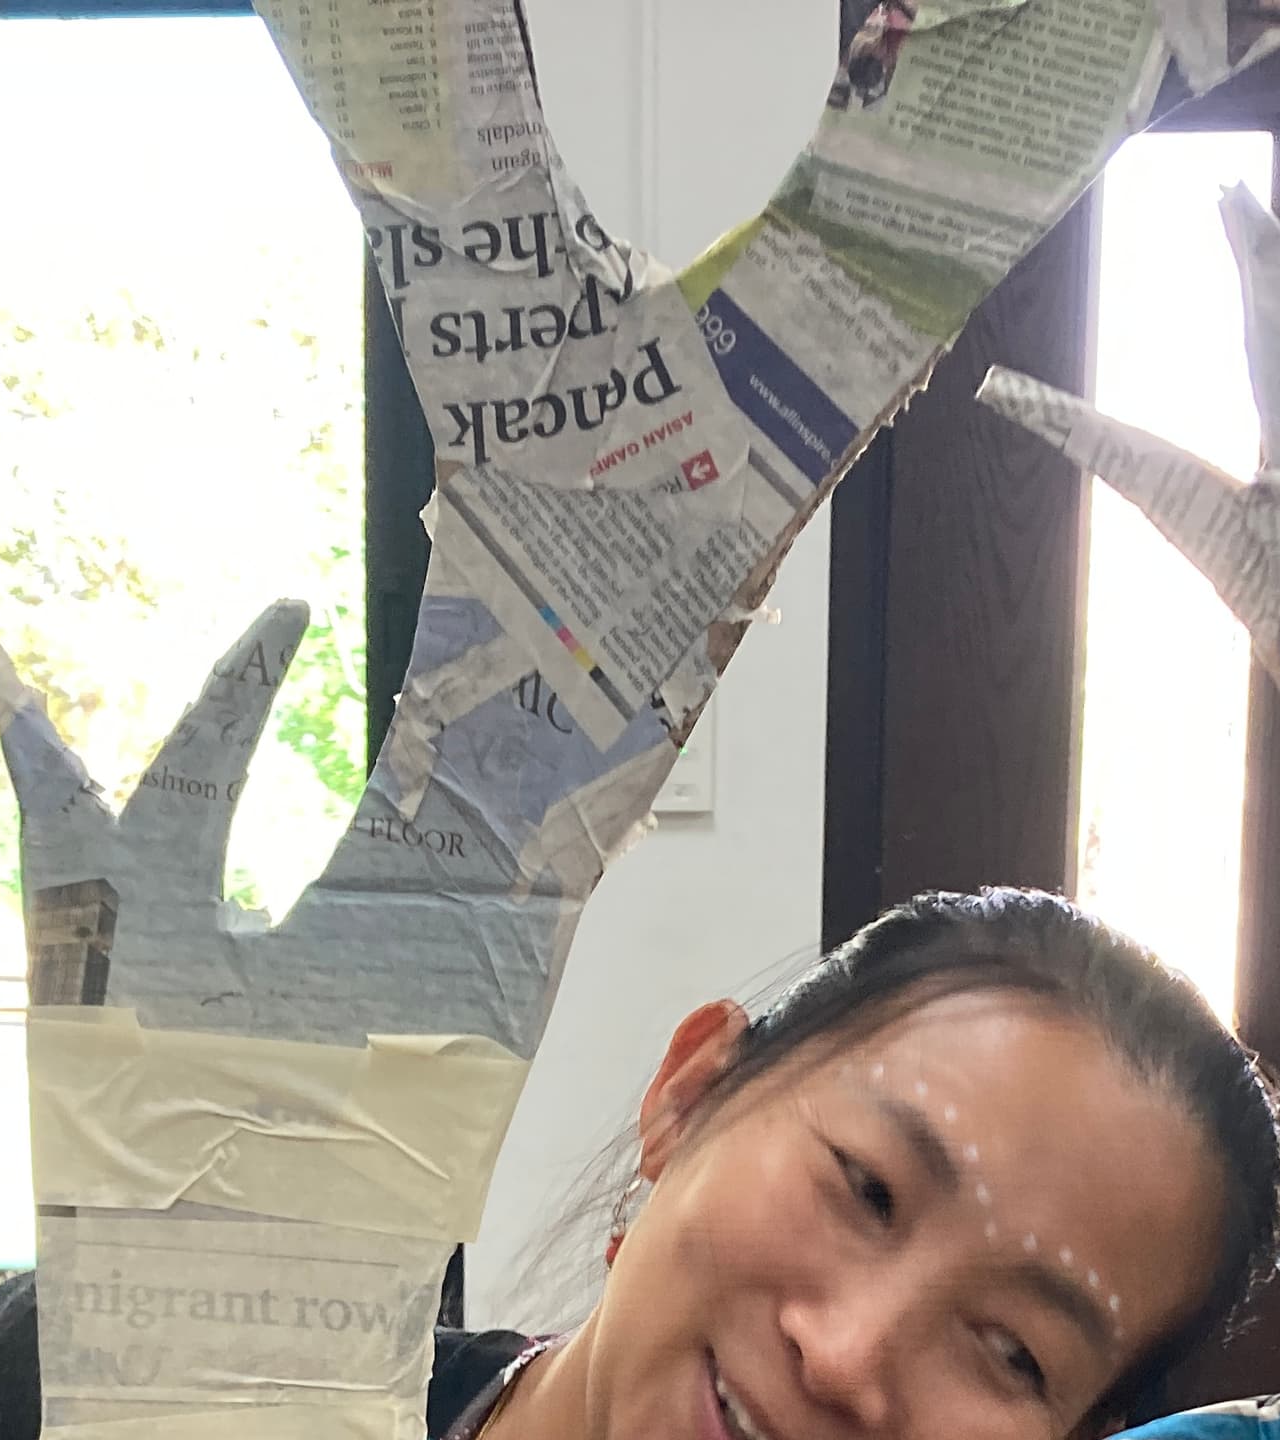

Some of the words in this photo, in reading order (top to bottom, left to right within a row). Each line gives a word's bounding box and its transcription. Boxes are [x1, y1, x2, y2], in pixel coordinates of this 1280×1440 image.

[477, 121, 542, 144] medals
[491, 150, 540, 171] again
[643, 410, 693, 446] ASIAN
[368, 815, 468, 859] FLOOR
